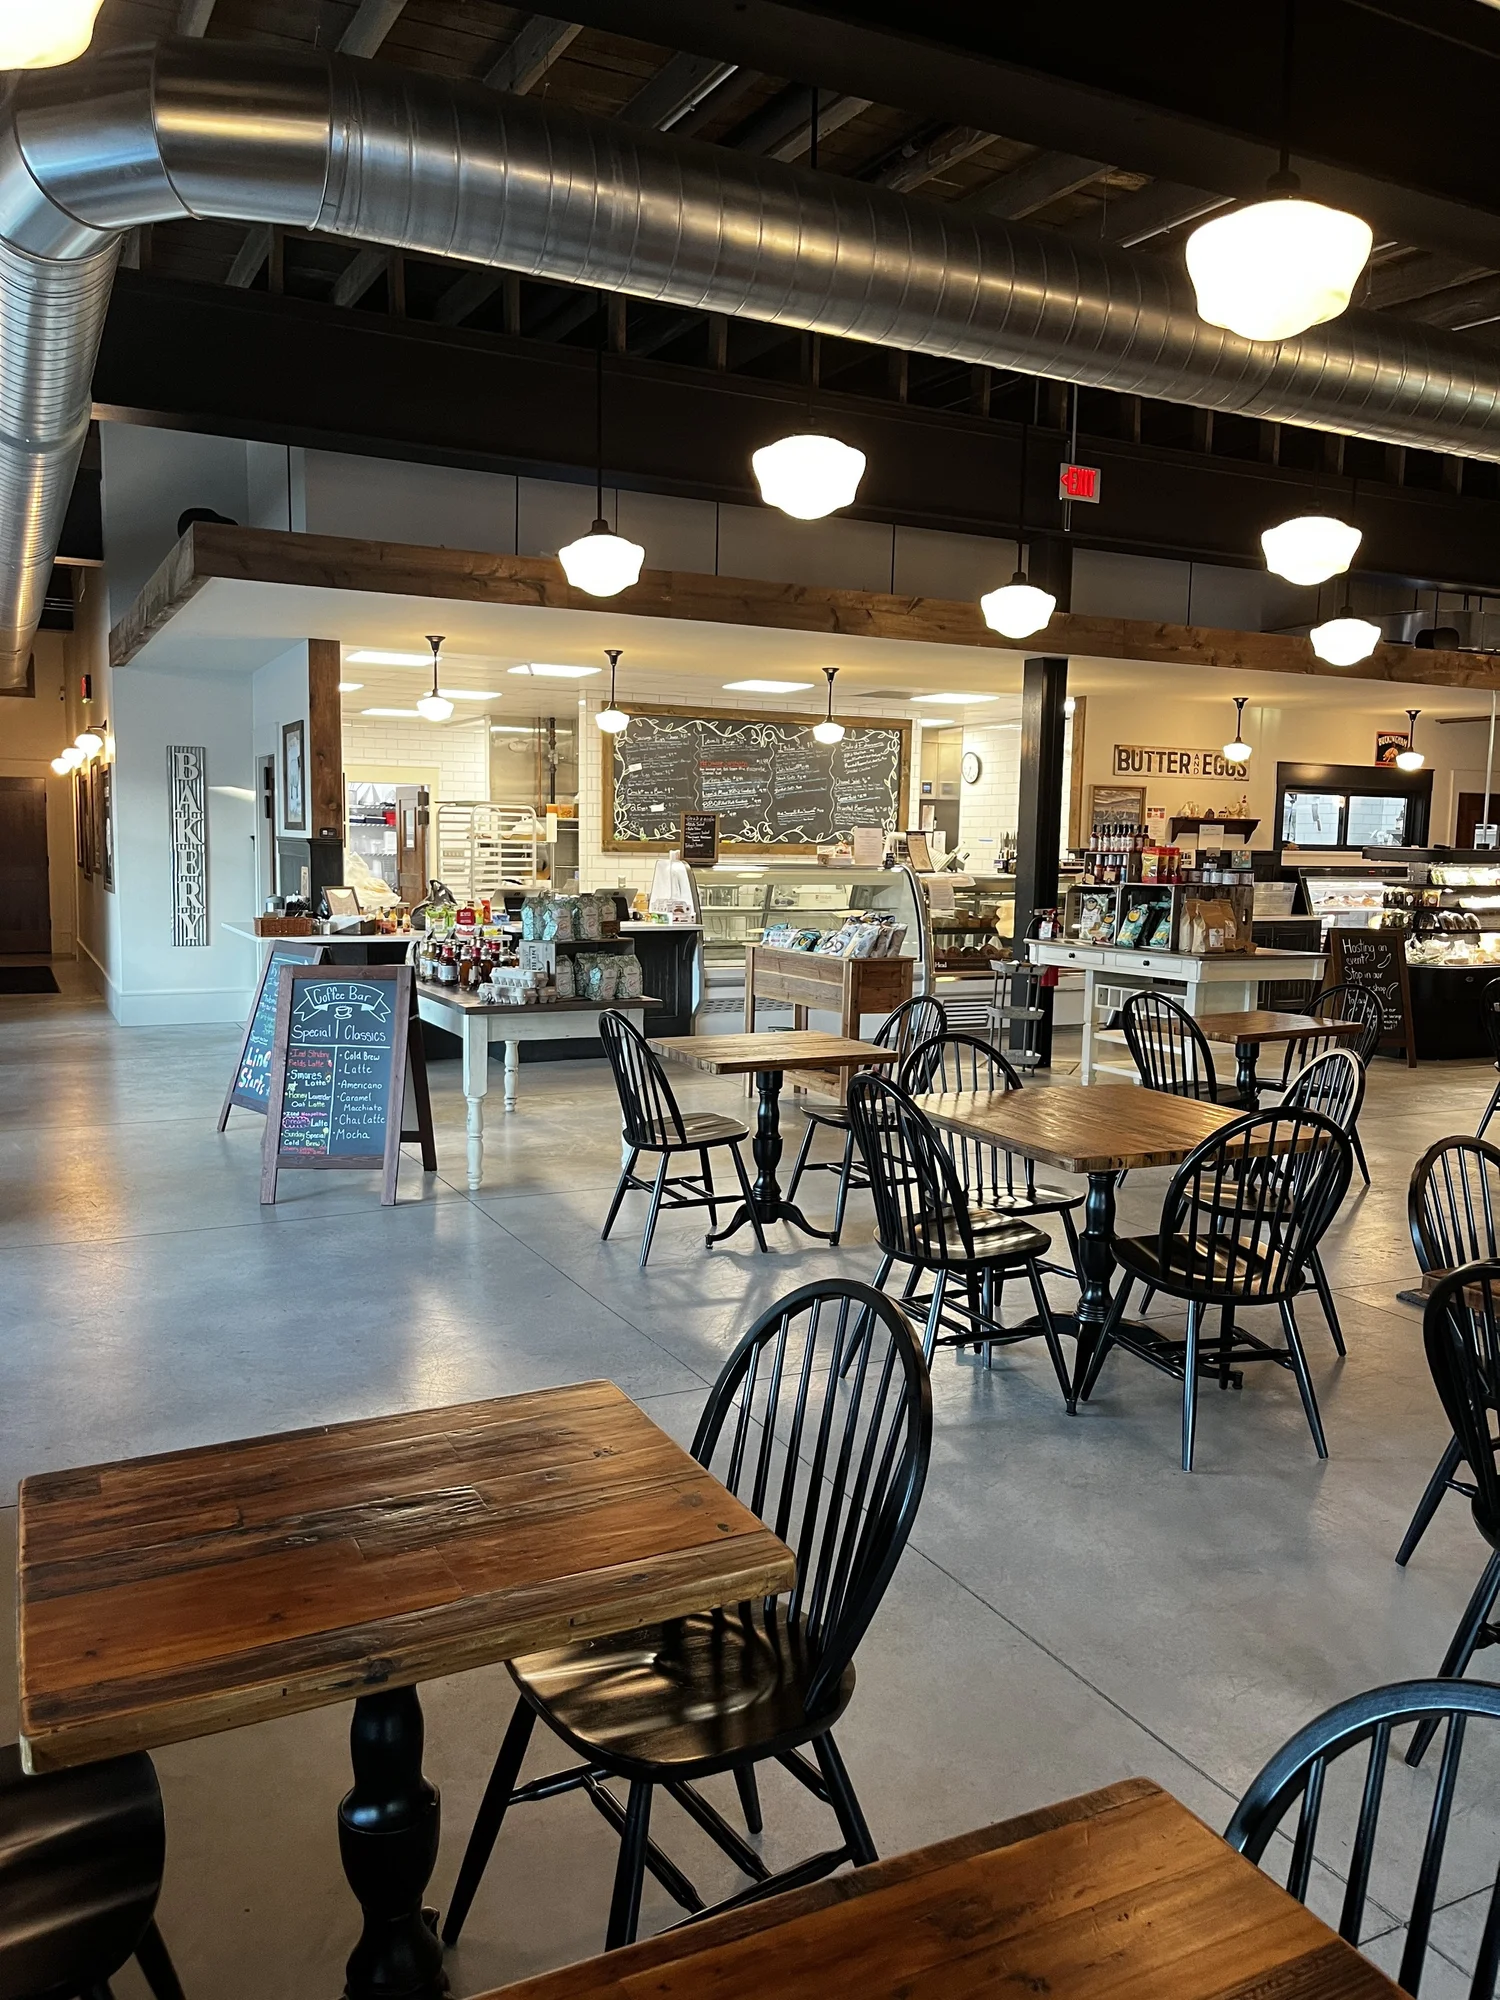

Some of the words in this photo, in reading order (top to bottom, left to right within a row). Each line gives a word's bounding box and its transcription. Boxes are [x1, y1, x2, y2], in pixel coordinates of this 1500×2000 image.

[1068, 466, 1096, 497] EXIT
[1117, 748, 1191, 774] BUTTER
[1202, 753, 1248, 777] EGGS
[174, 751, 206, 942] BAKERY
[1341, 938, 1376, 962] Hosting
[1377, 944, 1388, 952] an
[1345, 952, 1371, 966] event?
[1343, 966, 1363, 986] Stop
[1372, 971, 1384, 979] our
[313, 986, 346, 1005] Coffee
[349, 985, 373, 1002] Bar
[1372, 982, 1387, 995] shop
[291, 1023, 332, 1043] Special
[344, 1024, 386, 1042] Classics
[344, 1050, 361, 1061] Cold
[363, 1050, 381, 1061] Brew
[307, 1059, 325, 1068] Latte
[344, 1062, 373, 1075] Latte
[290, 1069, 323, 1080] Smores
[305, 1079, 327, 1087] Latte
[340, 1079, 384, 1090] Americano
[288, 1090, 308, 1102] Honey
[340, 1092, 372, 1102] Caramel
[291, 1100, 306, 1108] Oat
[308, 1100, 326, 1108] Latte
[343, 1103, 383, 1112] Macchiato
[310, 1118, 329, 1128] Latte
[339, 1113, 361, 1126] Chai
[335, 1128, 371, 1141] Mocha
[283, 1139, 300, 1147] Cold
[305, 1139, 321, 1147] Brew
